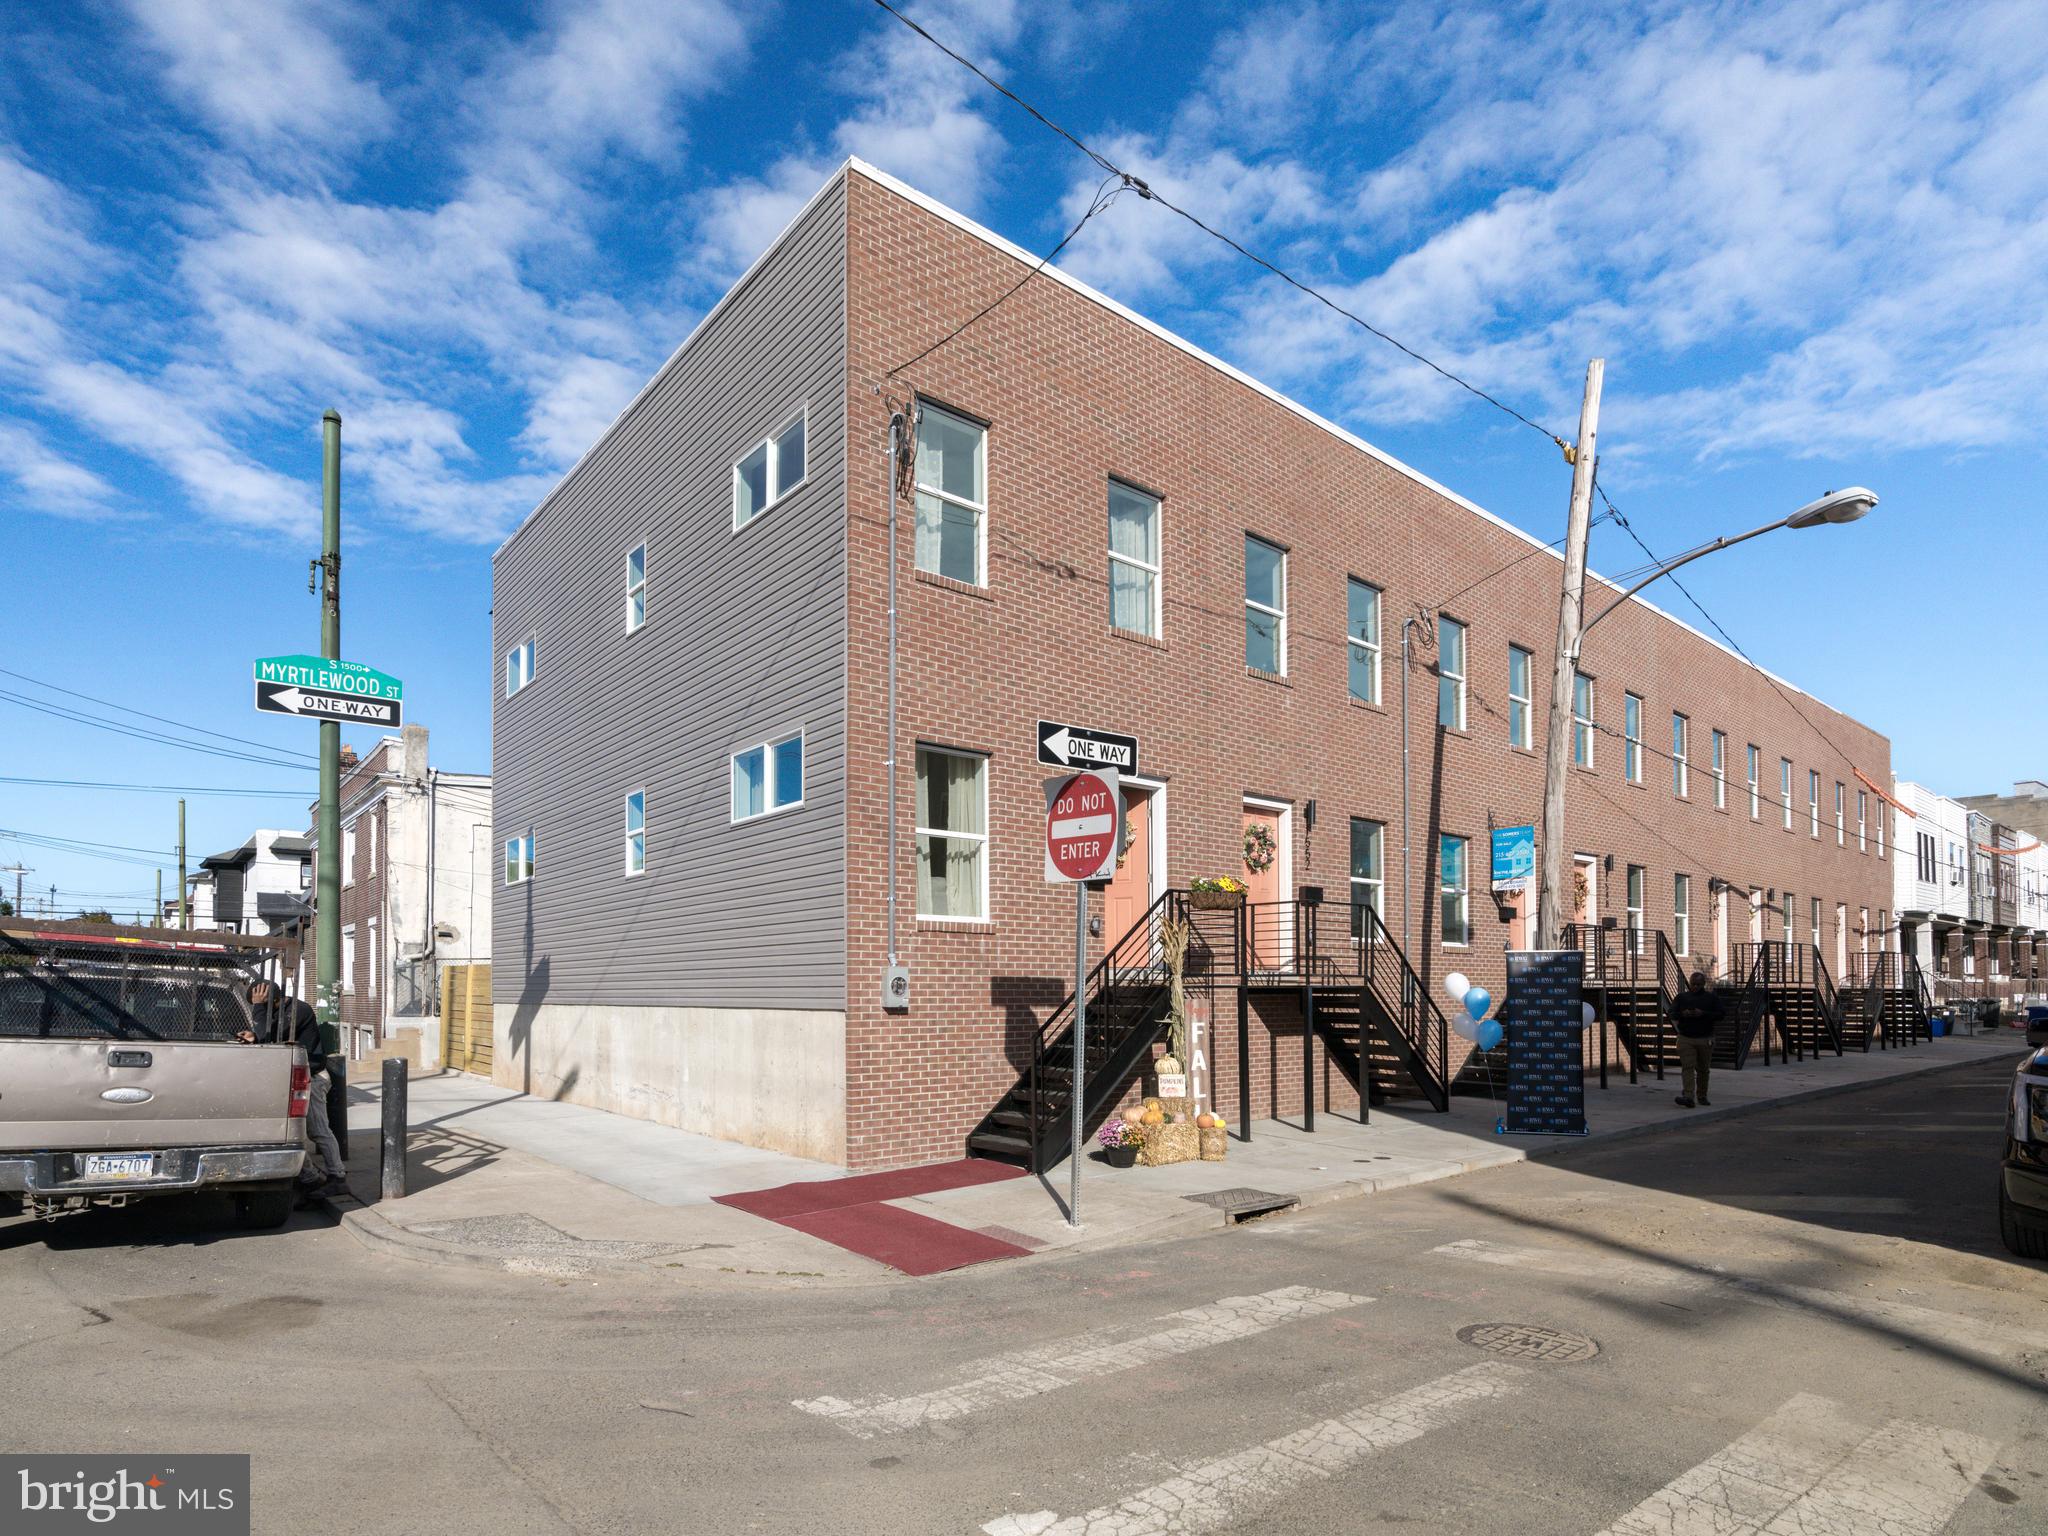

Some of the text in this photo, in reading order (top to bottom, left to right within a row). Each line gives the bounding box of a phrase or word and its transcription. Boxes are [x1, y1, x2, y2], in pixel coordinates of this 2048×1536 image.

[329, 660, 363, 671] S 1500
[262, 661, 399, 698] MYRTLEWOOD ST
[303, 696, 383, 717] ONE WAY
[1068, 739, 1126, 763] ONE WAY
[1057, 792, 1106, 815] DO NOT
[1060, 841, 1100, 860] ENTER
